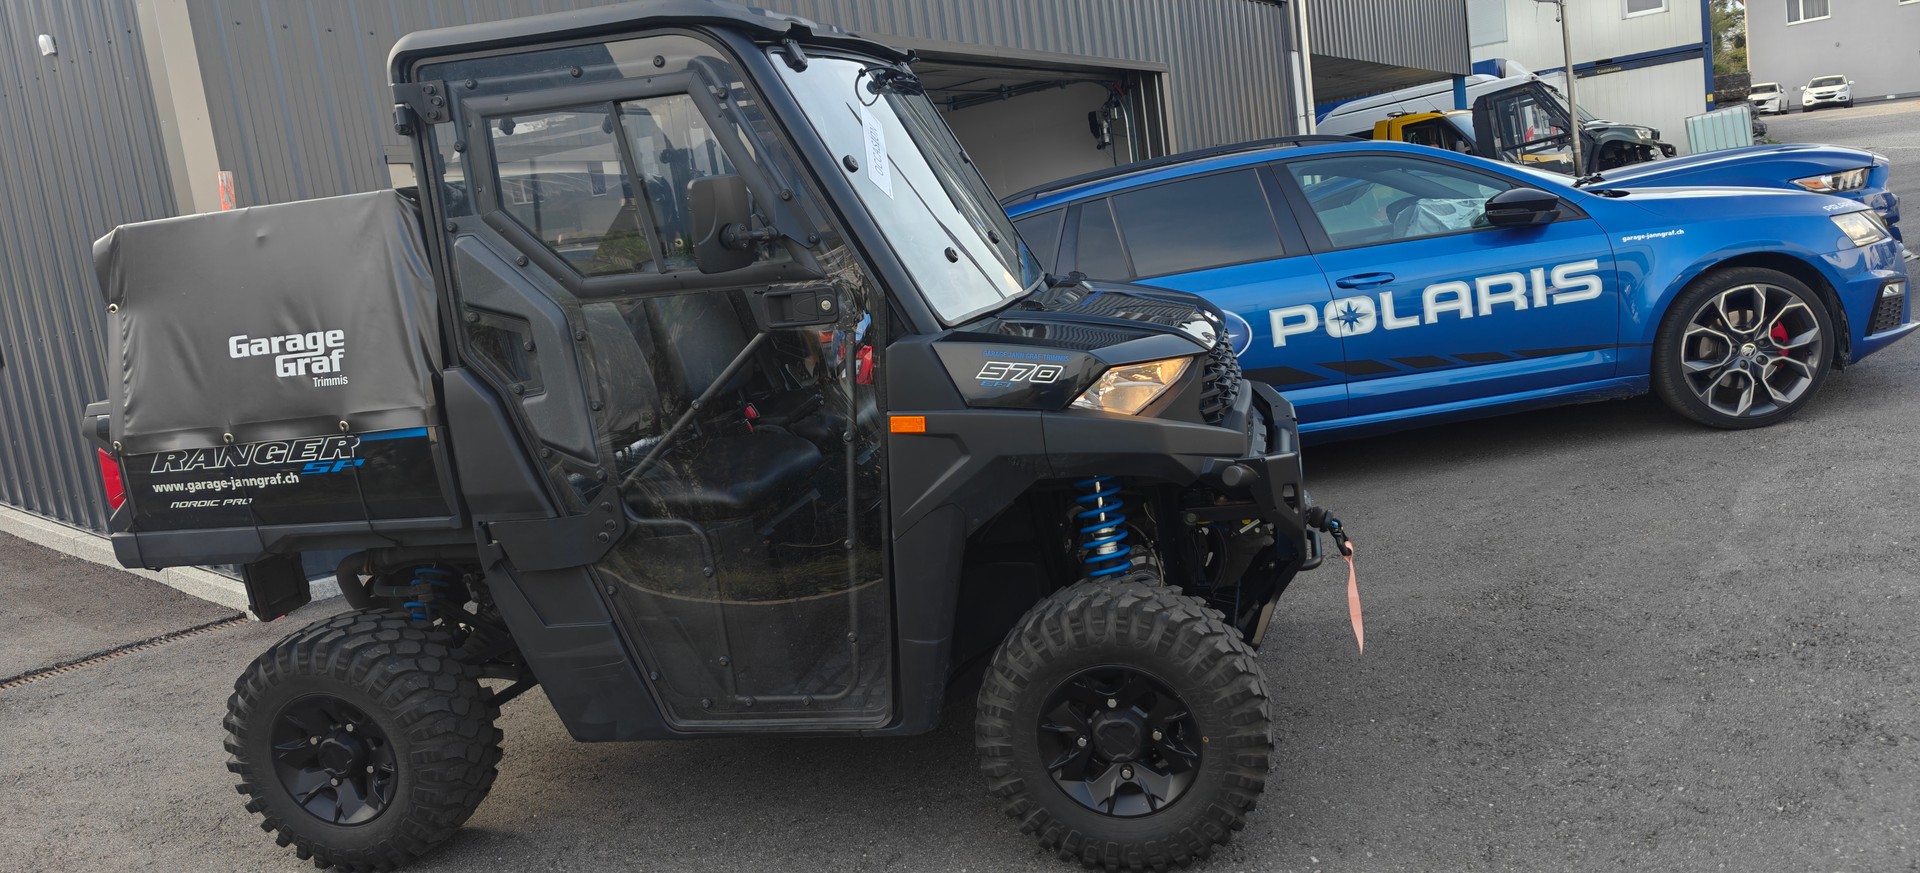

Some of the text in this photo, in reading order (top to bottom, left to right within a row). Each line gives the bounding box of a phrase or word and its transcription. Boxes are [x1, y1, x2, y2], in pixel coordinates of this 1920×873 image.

[869, 122, 884, 177] OCCASION
[1622, 229, 1685, 242] garage-janngraf.ch
[1269, 259, 1603, 348] POLARIS
[229, 329, 345, 358] Garage
[275, 348, 345, 378] Graf
[976, 361, 1064, 384] 570
[312, 375, 349, 388] Trimmis
[980, 380, 1012, 388] EFI
[150, 435, 361, 474] RANGER
[300, 458, 365, 475] SP
[152, 472, 300, 494] www.garage-janngraf.ch
[170, 499, 221, 509] NORDIC
